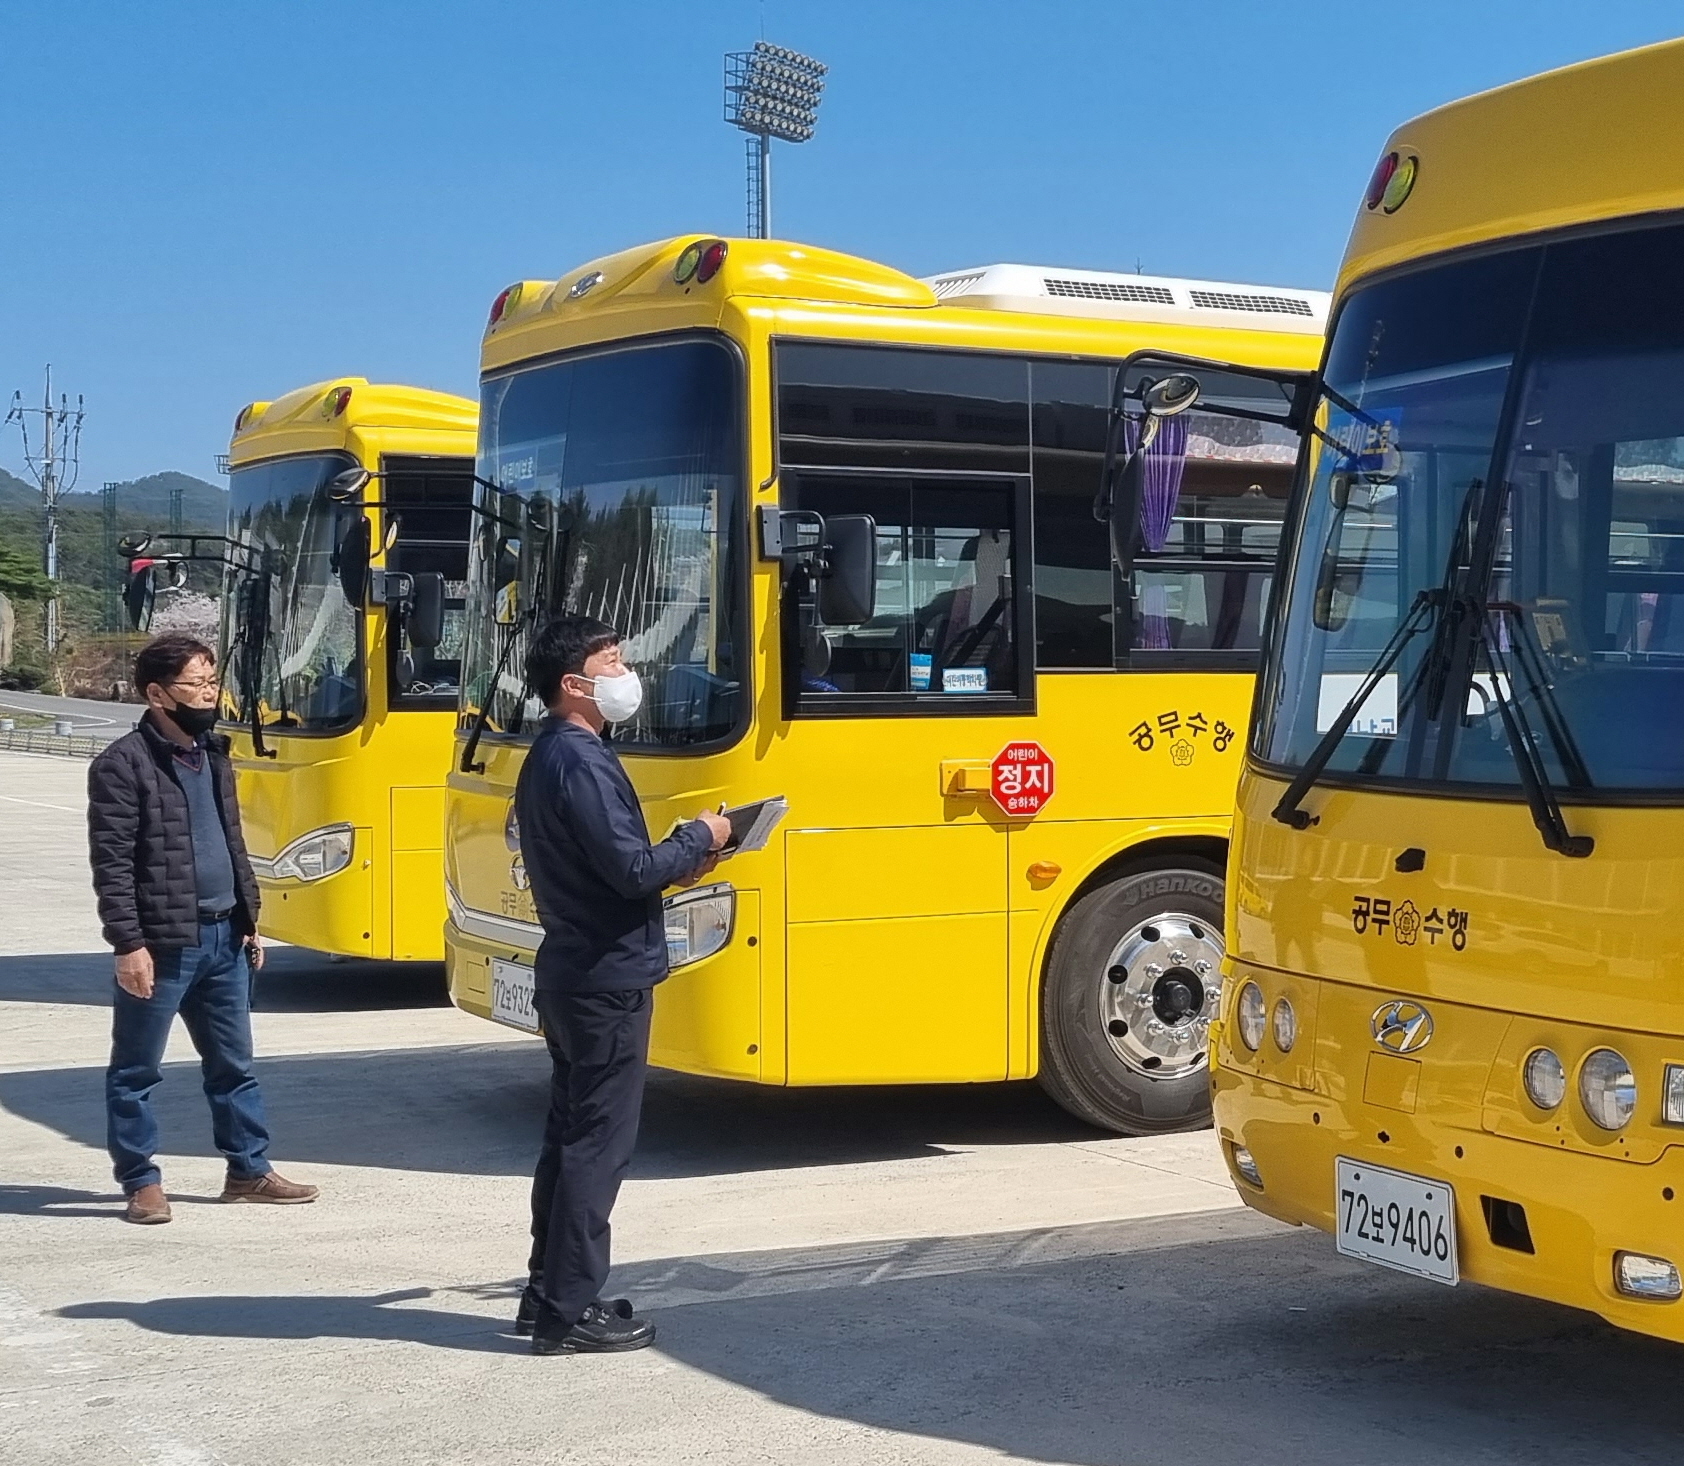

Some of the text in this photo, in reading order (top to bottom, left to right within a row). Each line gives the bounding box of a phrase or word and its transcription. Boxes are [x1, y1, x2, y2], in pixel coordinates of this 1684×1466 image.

[1128, 710, 1236, 753] 공무수행
[1007, 748, 1039, 761] 어린이
[997, 763, 1049, 795] 정지
[1007, 796, 1039, 810] 승하차
[1351, 895, 1392, 936] 공무
[1423, 907, 1469, 952] 수행
[1341, 1188, 1449, 1262] 72보9406
